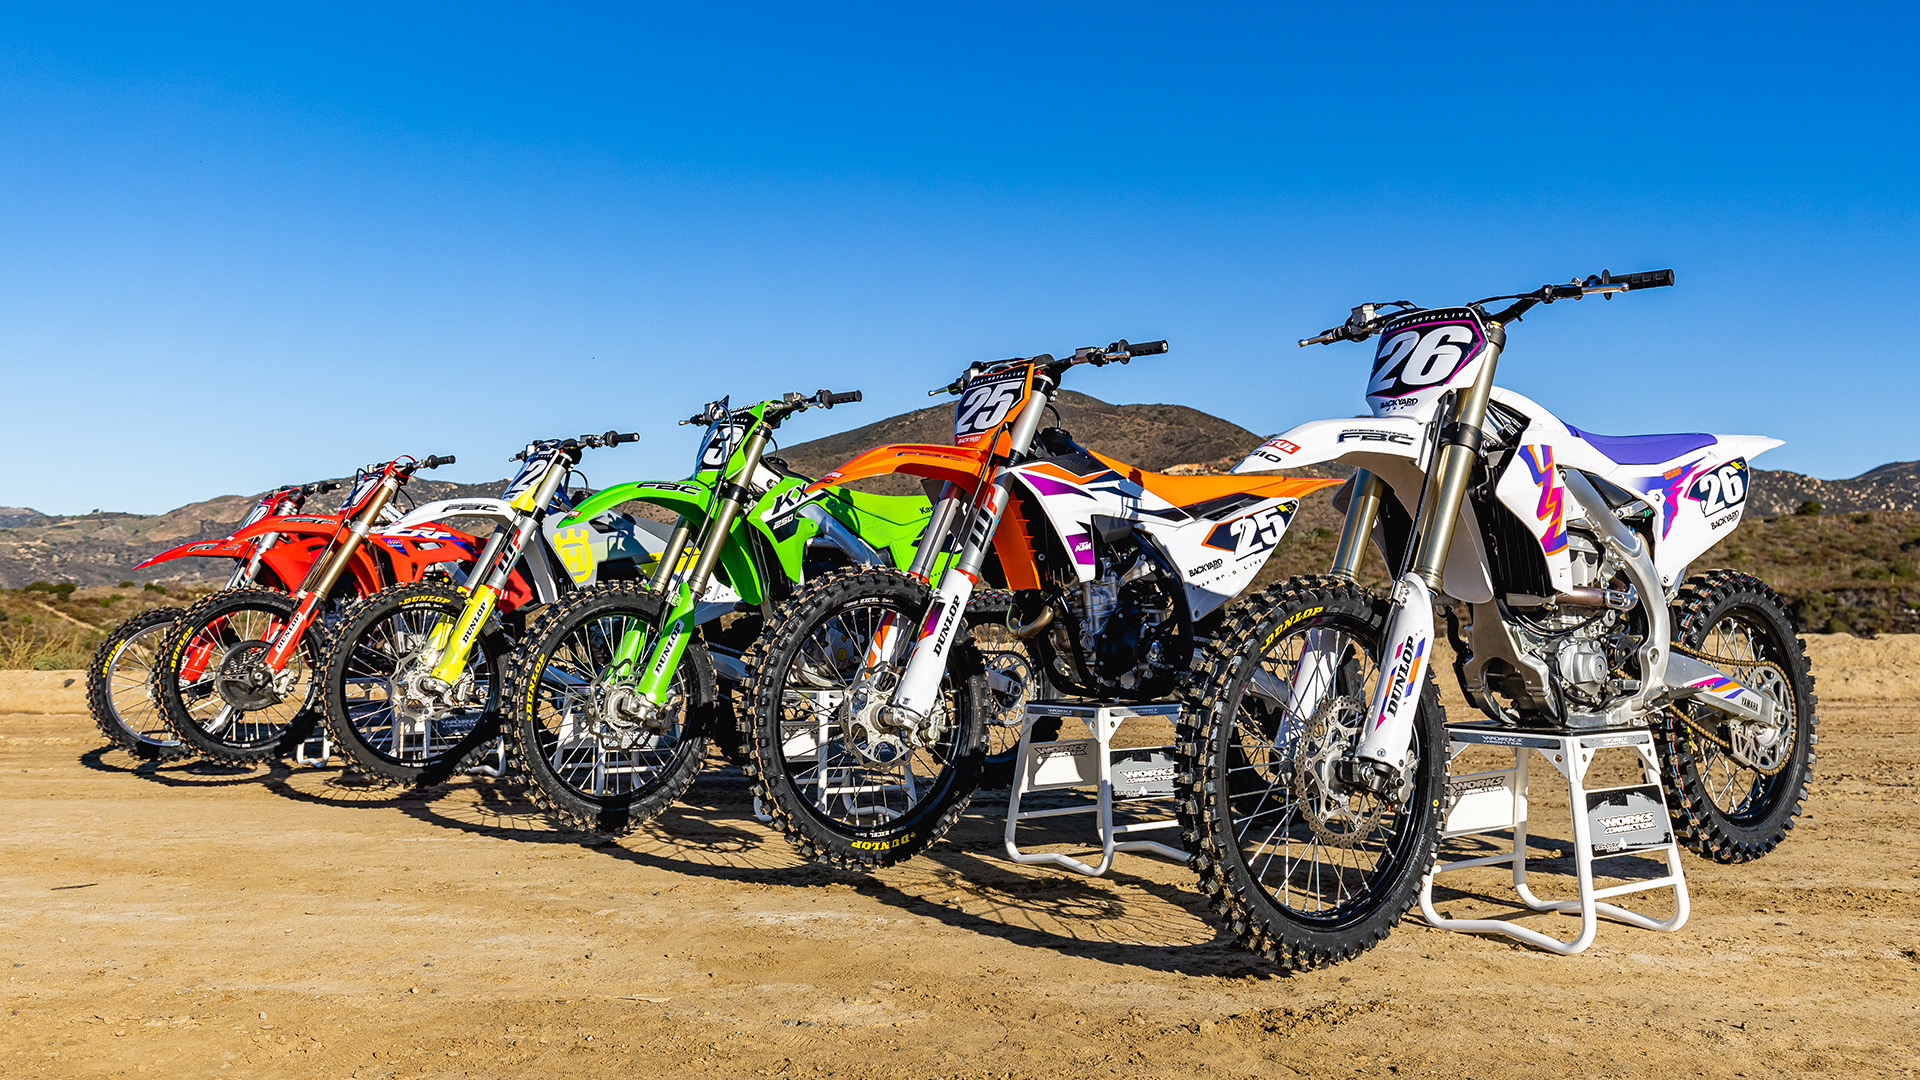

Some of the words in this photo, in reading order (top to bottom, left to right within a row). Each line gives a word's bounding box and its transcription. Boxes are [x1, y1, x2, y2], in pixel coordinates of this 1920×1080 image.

[1385, 321, 1406, 332] SWAP
[1411, 315, 1436, 324] MOTO
[1369, 325, 1473, 395] 26
[956, 381, 1023, 434] 25
[1379, 397, 1419, 409] BACKYARD
[1336, 431, 1416, 446] FBC
[1663, 466, 1683, 481] 250F
[636, 481, 702, 496] FBC
[1700, 466, 1745, 518] 26
[772, 481, 810, 516] KX
[773, 515, 794, 531] 250
[1710, 510, 1740, 531] BACKYARD
[1229, 507, 1287, 558] 25
[1074, 541, 1092, 553] KTM
[1188, 558, 1223, 577] BACKYARD
[402, 596, 452, 605] DUNLOP
[276, 611, 302, 650] DUNLOP
[462, 601, 487, 644] DUNLOP
[933, 595, 961, 657] DUNLOP
[1263, 606, 1325, 651] DUNLOP
[102, 638, 126, 675] DUNLOP
[171, 626, 194, 671] DUNLOP
[655, 622, 681, 675] DUNLOP
[526, 653, 546, 717] DUNLOP
[1386, 636, 1414, 718] DUNLOP
[1741, 696, 1759, 712] YAMAHA
[1482, 735, 1523, 744] WORKS
[1034, 743, 1089, 754] WORKS
[1119, 767, 1175, 779] WORKS
[1451, 776, 1506, 791] WORKS
[1453, 785, 1505, 797] CONNECTION
[1597, 811, 1655, 828] WORKS
[1603, 821, 1658, 835] CONNECTION
[851, 834, 910, 851] DUNLOP
